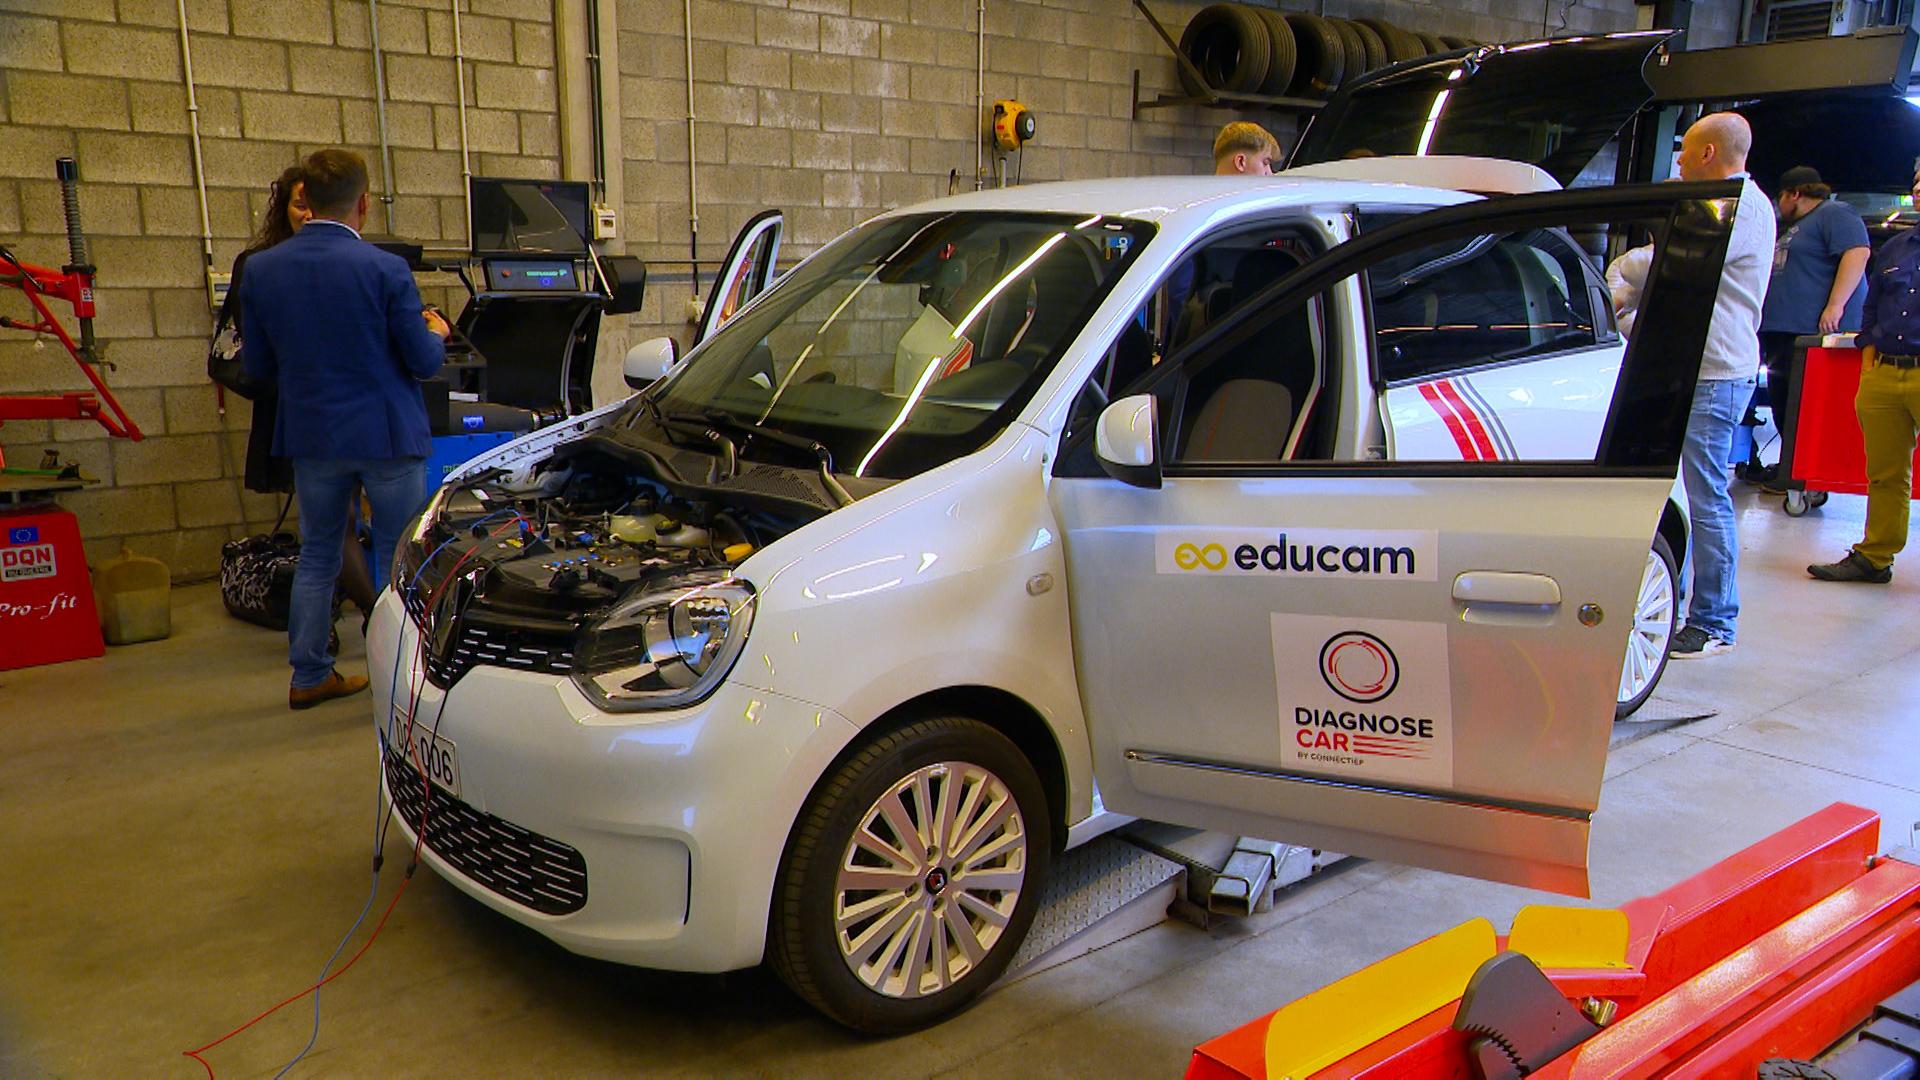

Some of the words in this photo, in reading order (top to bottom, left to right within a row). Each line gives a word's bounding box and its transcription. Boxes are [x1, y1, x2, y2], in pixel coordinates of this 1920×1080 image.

[1234, 533, 1415, 574] educam
[1295, 707, 1434, 738] DIAGNOSE
[1296, 729, 1349, 752] CAR
[1297, 751, 1308, 760] BY
